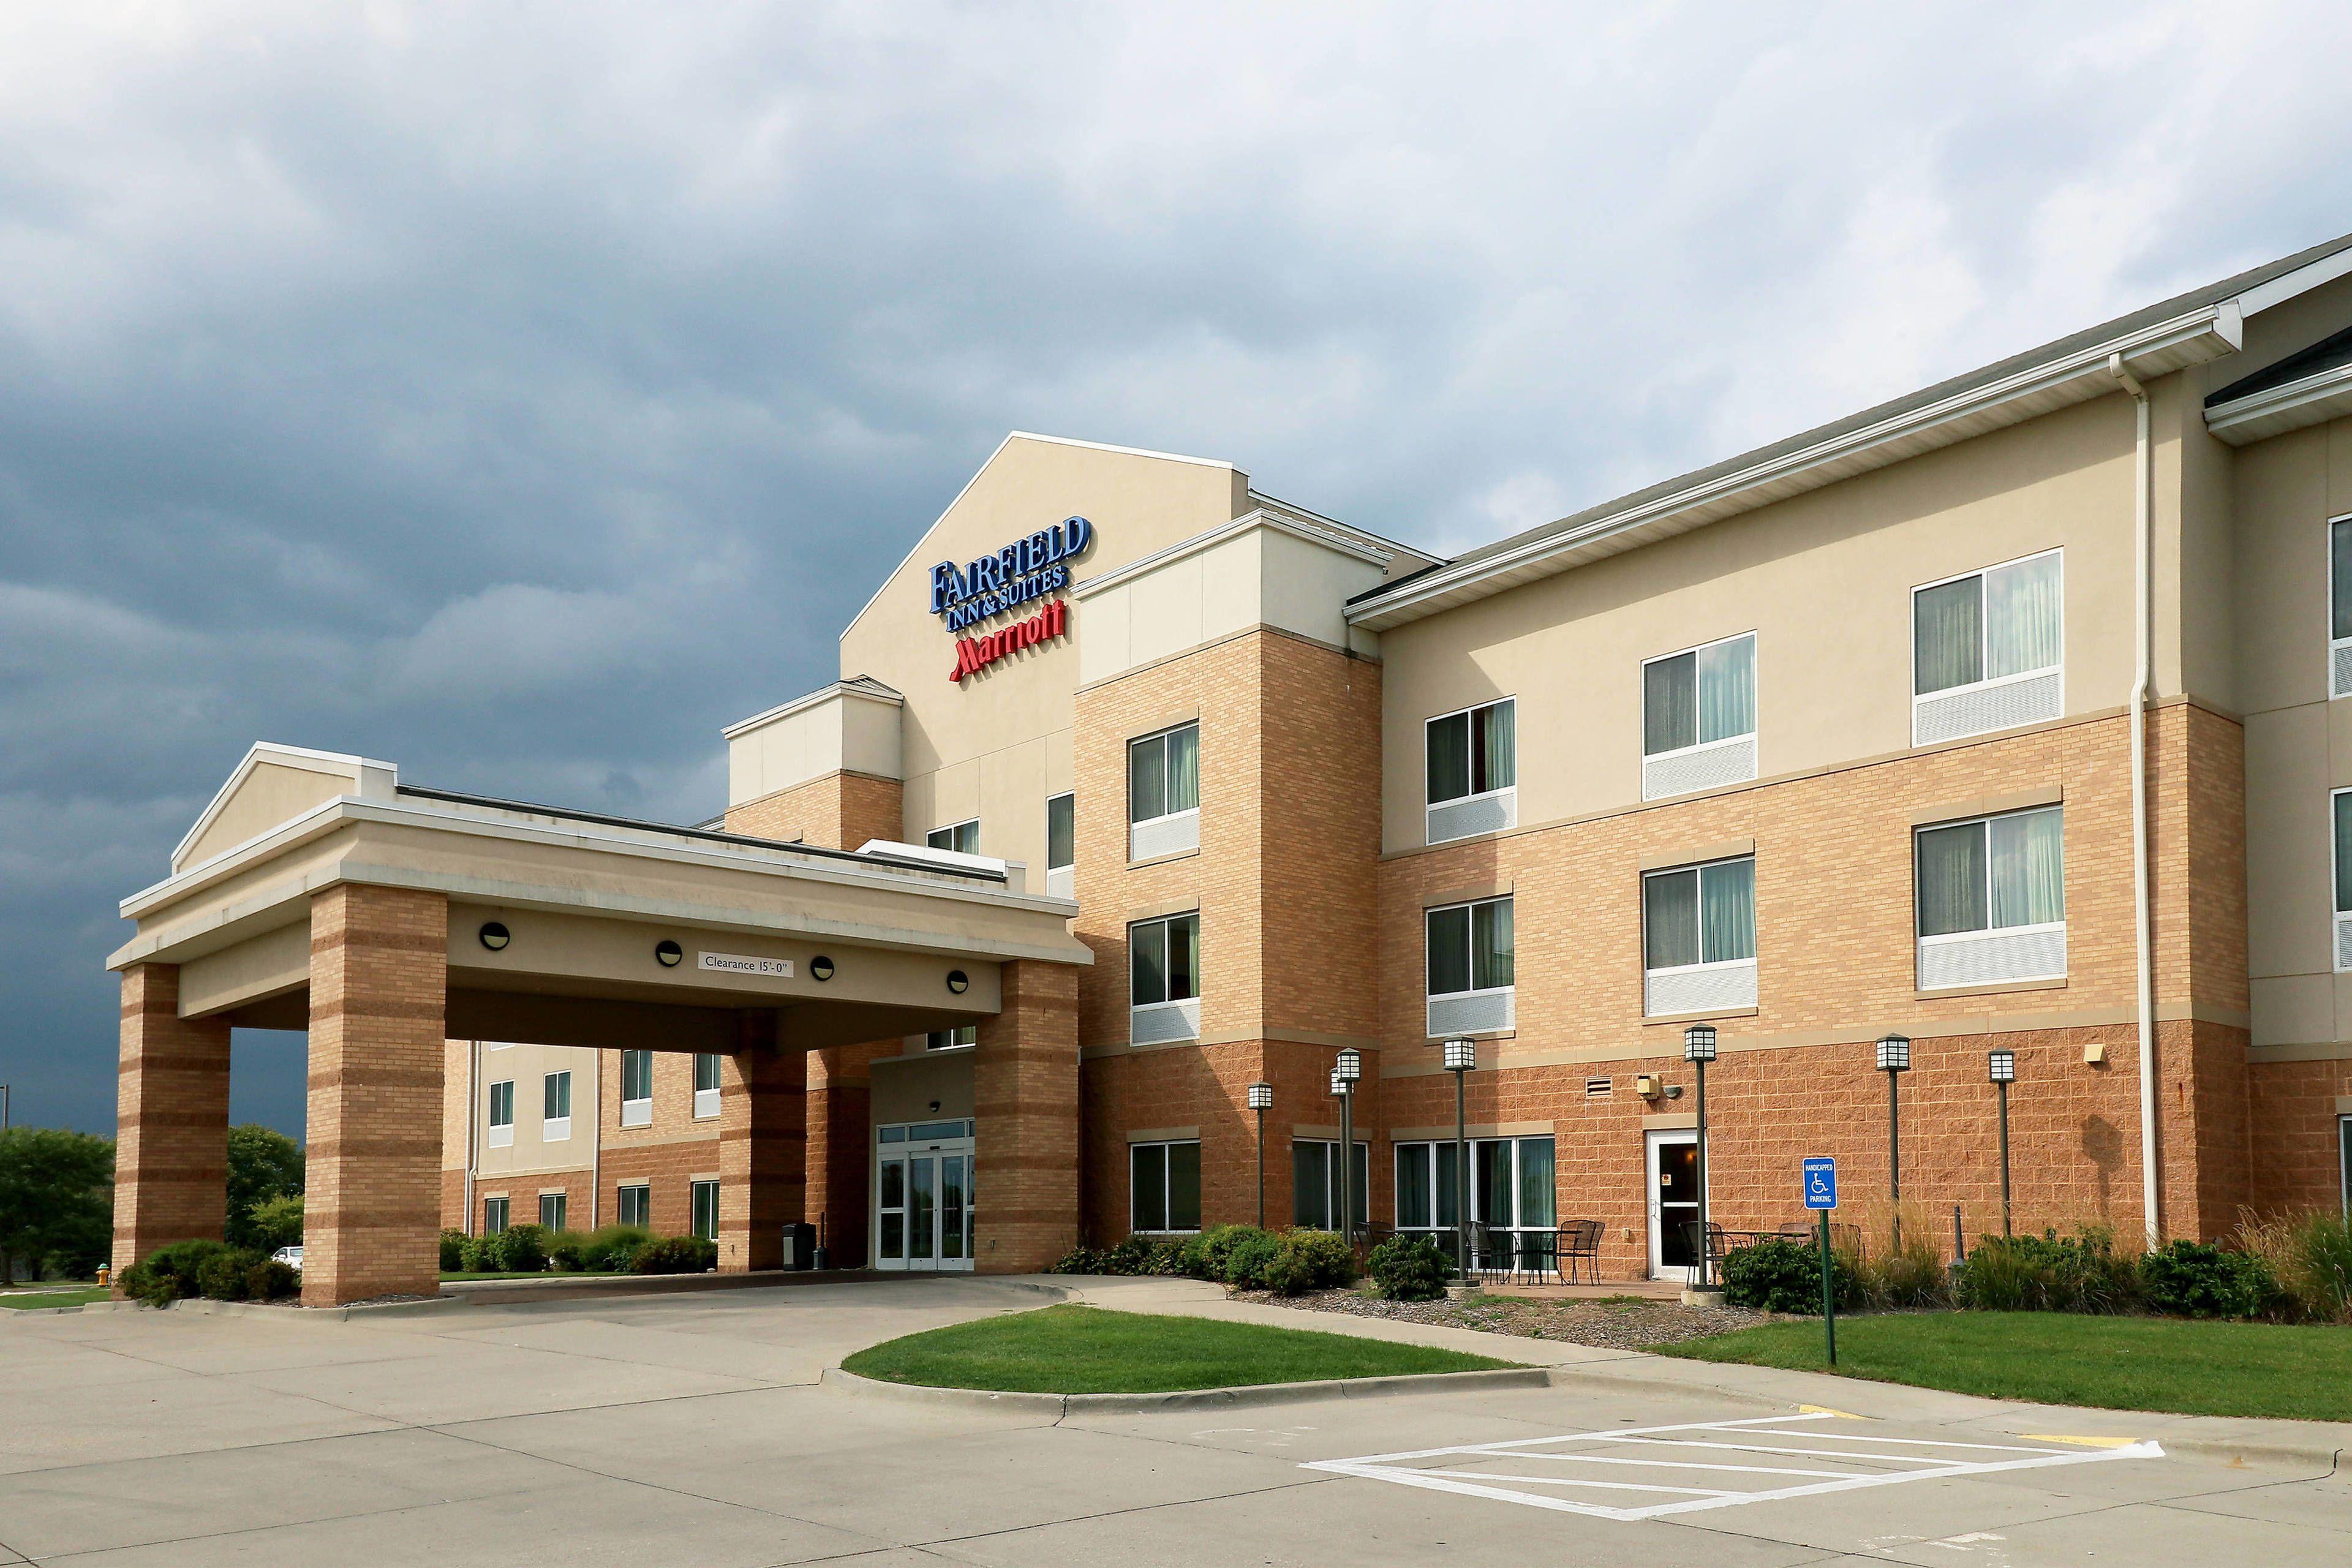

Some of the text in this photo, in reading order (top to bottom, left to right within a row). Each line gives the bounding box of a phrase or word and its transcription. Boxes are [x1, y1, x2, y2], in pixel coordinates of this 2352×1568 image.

[929, 516, 1090, 614] FAIRFIELD
[946, 565, 1068, 633] INN & SUITES
[949, 599, 1066, 682] Marriott
[705, 956, 755, 970] Clearance
